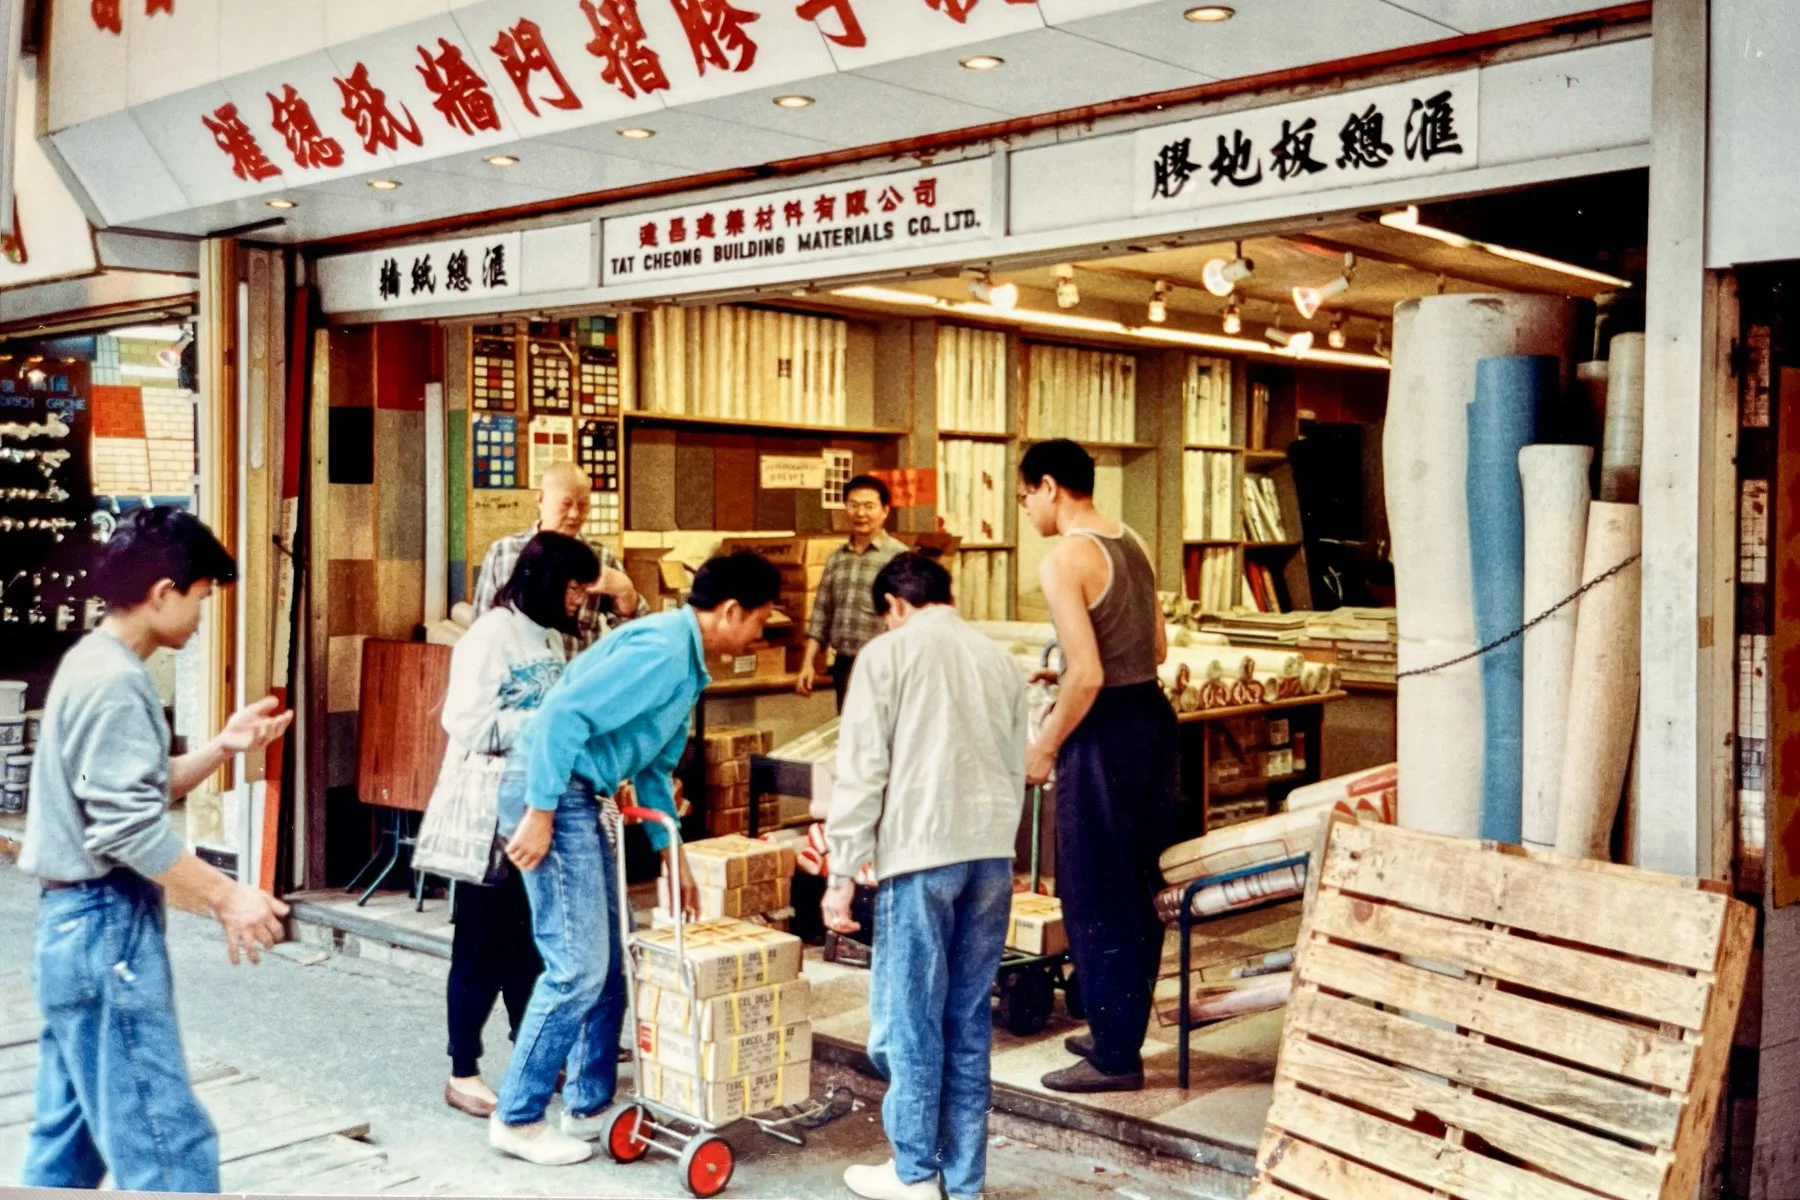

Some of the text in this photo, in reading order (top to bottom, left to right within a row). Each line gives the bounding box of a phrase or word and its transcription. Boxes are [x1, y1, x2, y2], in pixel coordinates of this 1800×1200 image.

[611, 256, 634, 275] TAT
[643, 247, 702, 271] CHEONG
[713, 236, 785, 263] BUILDING
[798, 221, 894, 252] MATERIALS
